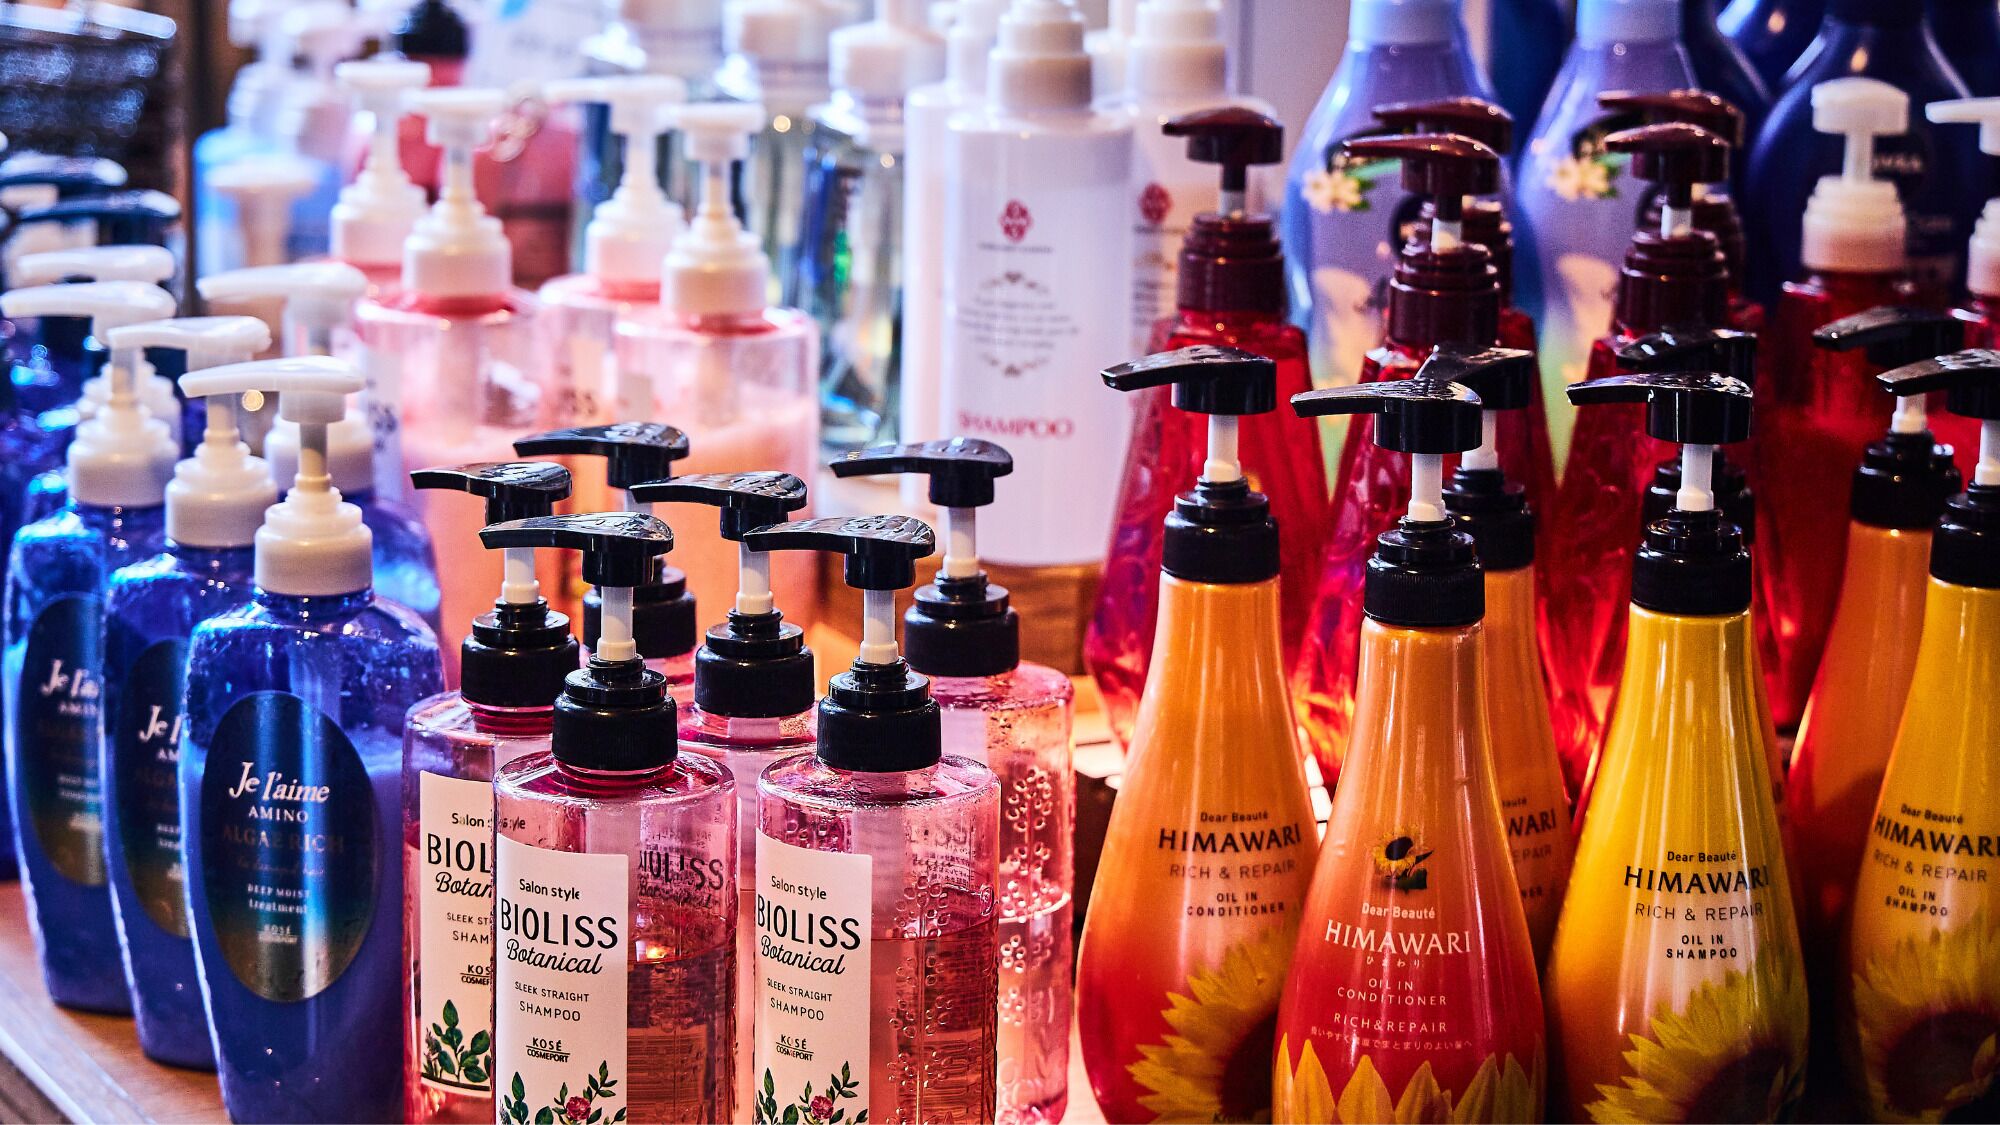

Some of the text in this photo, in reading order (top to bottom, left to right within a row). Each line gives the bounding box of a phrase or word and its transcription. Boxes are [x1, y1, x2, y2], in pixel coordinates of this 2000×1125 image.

[138, 705, 169, 742] Je
[229, 761, 330, 803] Je l'aime
[248, 805, 309, 824] AMINO
[1200, 810, 1269, 823] Dear Beauté
[1901, 803, 1921, 817] Dear
[1158, 823, 1302, 854] HIMAWARI
[428, 833, 491, 873] BIOL
[1667, 850, 1737, 863] Dear Beauté
[1169, 858, 1297, 880] RICH & REPAIR
[1904, 861, 1914, 875] &
[1921, 863, 1988, 882] REPAIR
[519, 878, 580, 902] Salon style
[771, 875, 827, 901] Salon style
[1624, 865, 1769, 895] HIMAWARI
[1216, 891, 1258, 903] OIL IN
[1898, 885, 1936, 901] OIL IN
[1186, 901, 1286, 917] CONDITIONER
[1361, 902, 1436, 919] Dear Beauté
[1635, 902, 1763, 921] RICH & REPAIR
[1885, 896, 1948, 916] SHAMPOO
[447, 912, 473, 924] SLEEK
[501, 897, 618, 950] BIOLISS
[758, 893, 861, 950] BIOLISS
[453, 931, 489, 944] SHAM
[1324, 919, 1471, 956] HIMAWARI
[1681, 934, 1723, 945] OIL IN
[506, 938, 603, 975] Botanical
[761, 934, 846, 975] Botanical
[1666, 947, 1738, 960] SHAMPOO
[467, 964, 491, 976] KOS
[515, 981, 590, 1003] SLEEK STRAIGHT
[767, 977, 833, 1002] SLEEK STRAIGHT
[1368, 977, 1413, 991] OIL IN
[1337, 986, 1447, 1006] CONDITIONER
[519, 1000, 581, 1022] SHAMPOO
[770, 997, 825, 1021] SHAMPOO
[532, 1036, 562, 1052] KOSÉ
[526, 1048, 569, 1063] COSMEPORT
